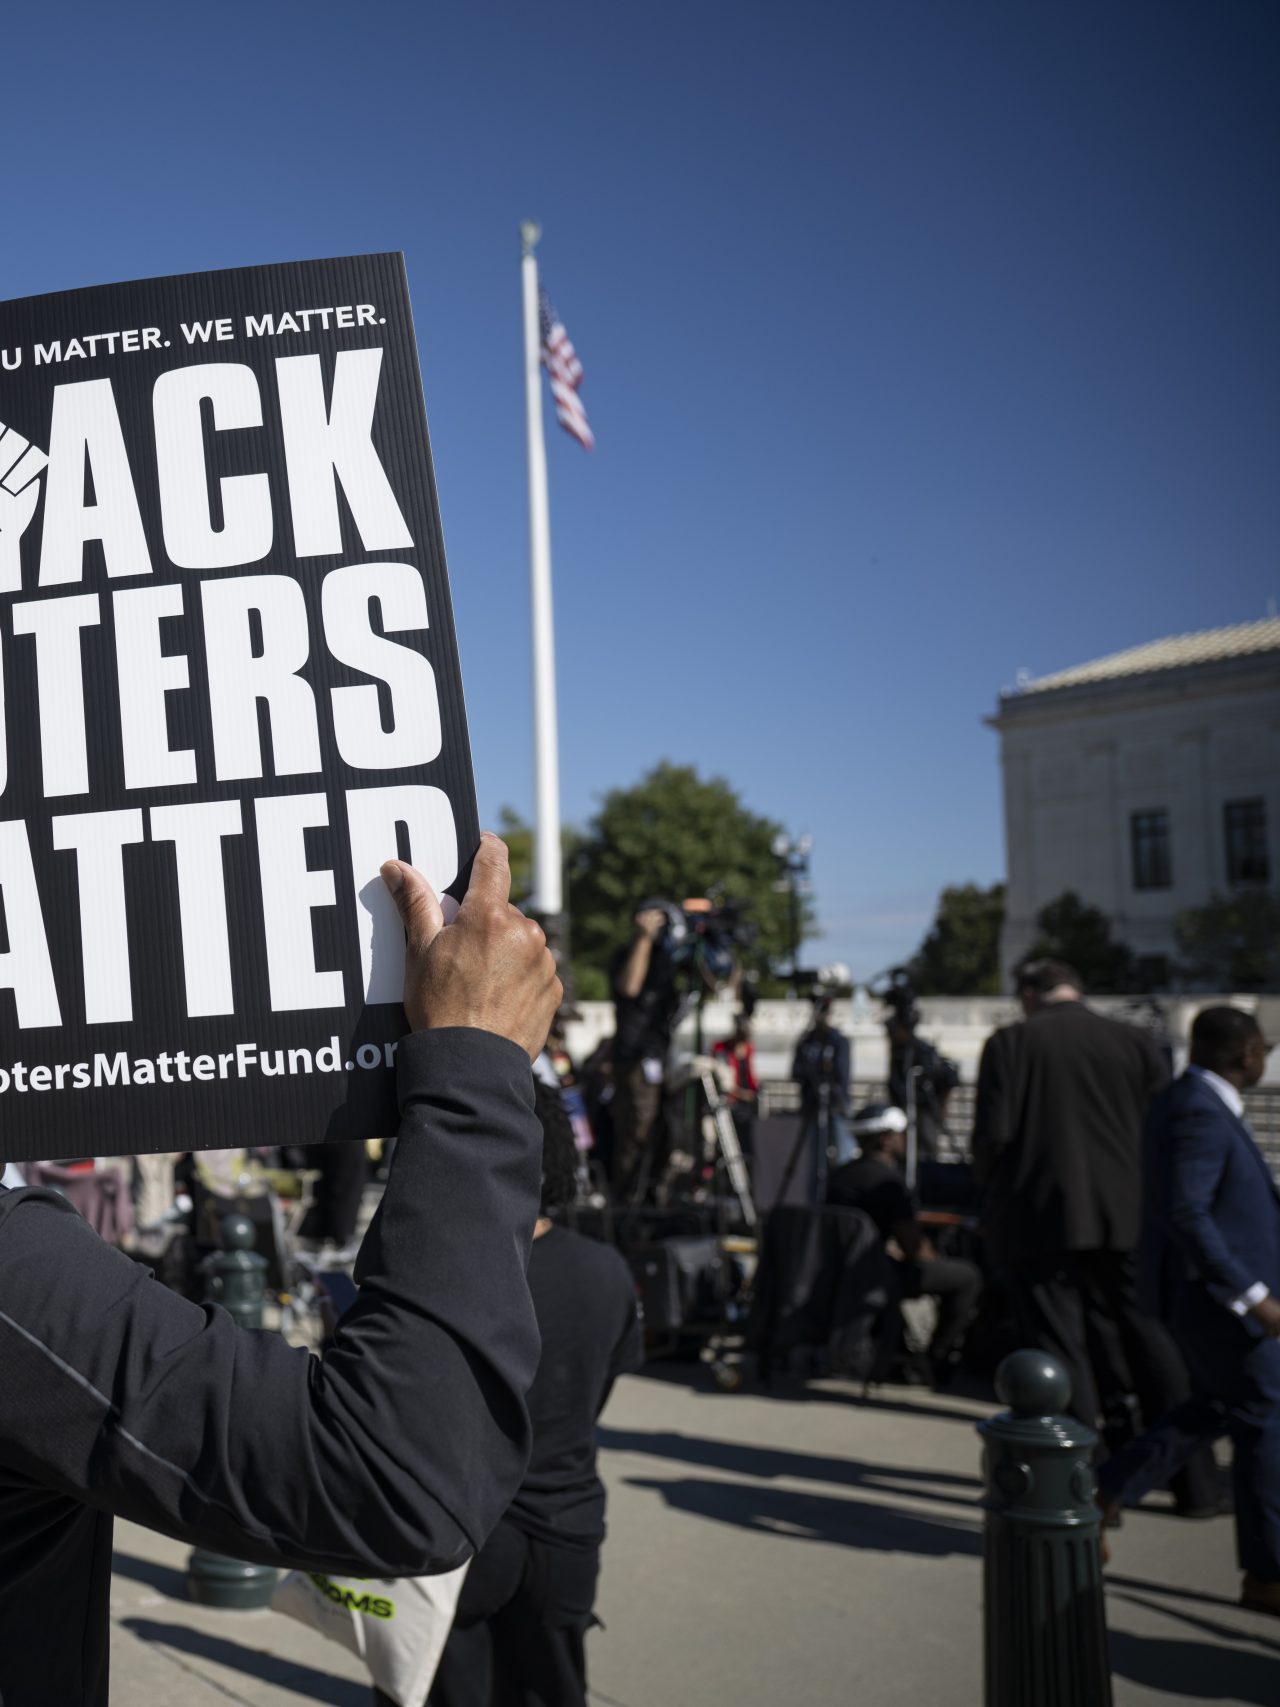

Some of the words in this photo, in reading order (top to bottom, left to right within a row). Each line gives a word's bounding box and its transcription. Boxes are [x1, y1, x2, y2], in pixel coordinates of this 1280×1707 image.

[33, 326, 172, 367] MATTER.
[179, 317, 236, 345] WE
[244, 303, 387, 339] MATTER.
